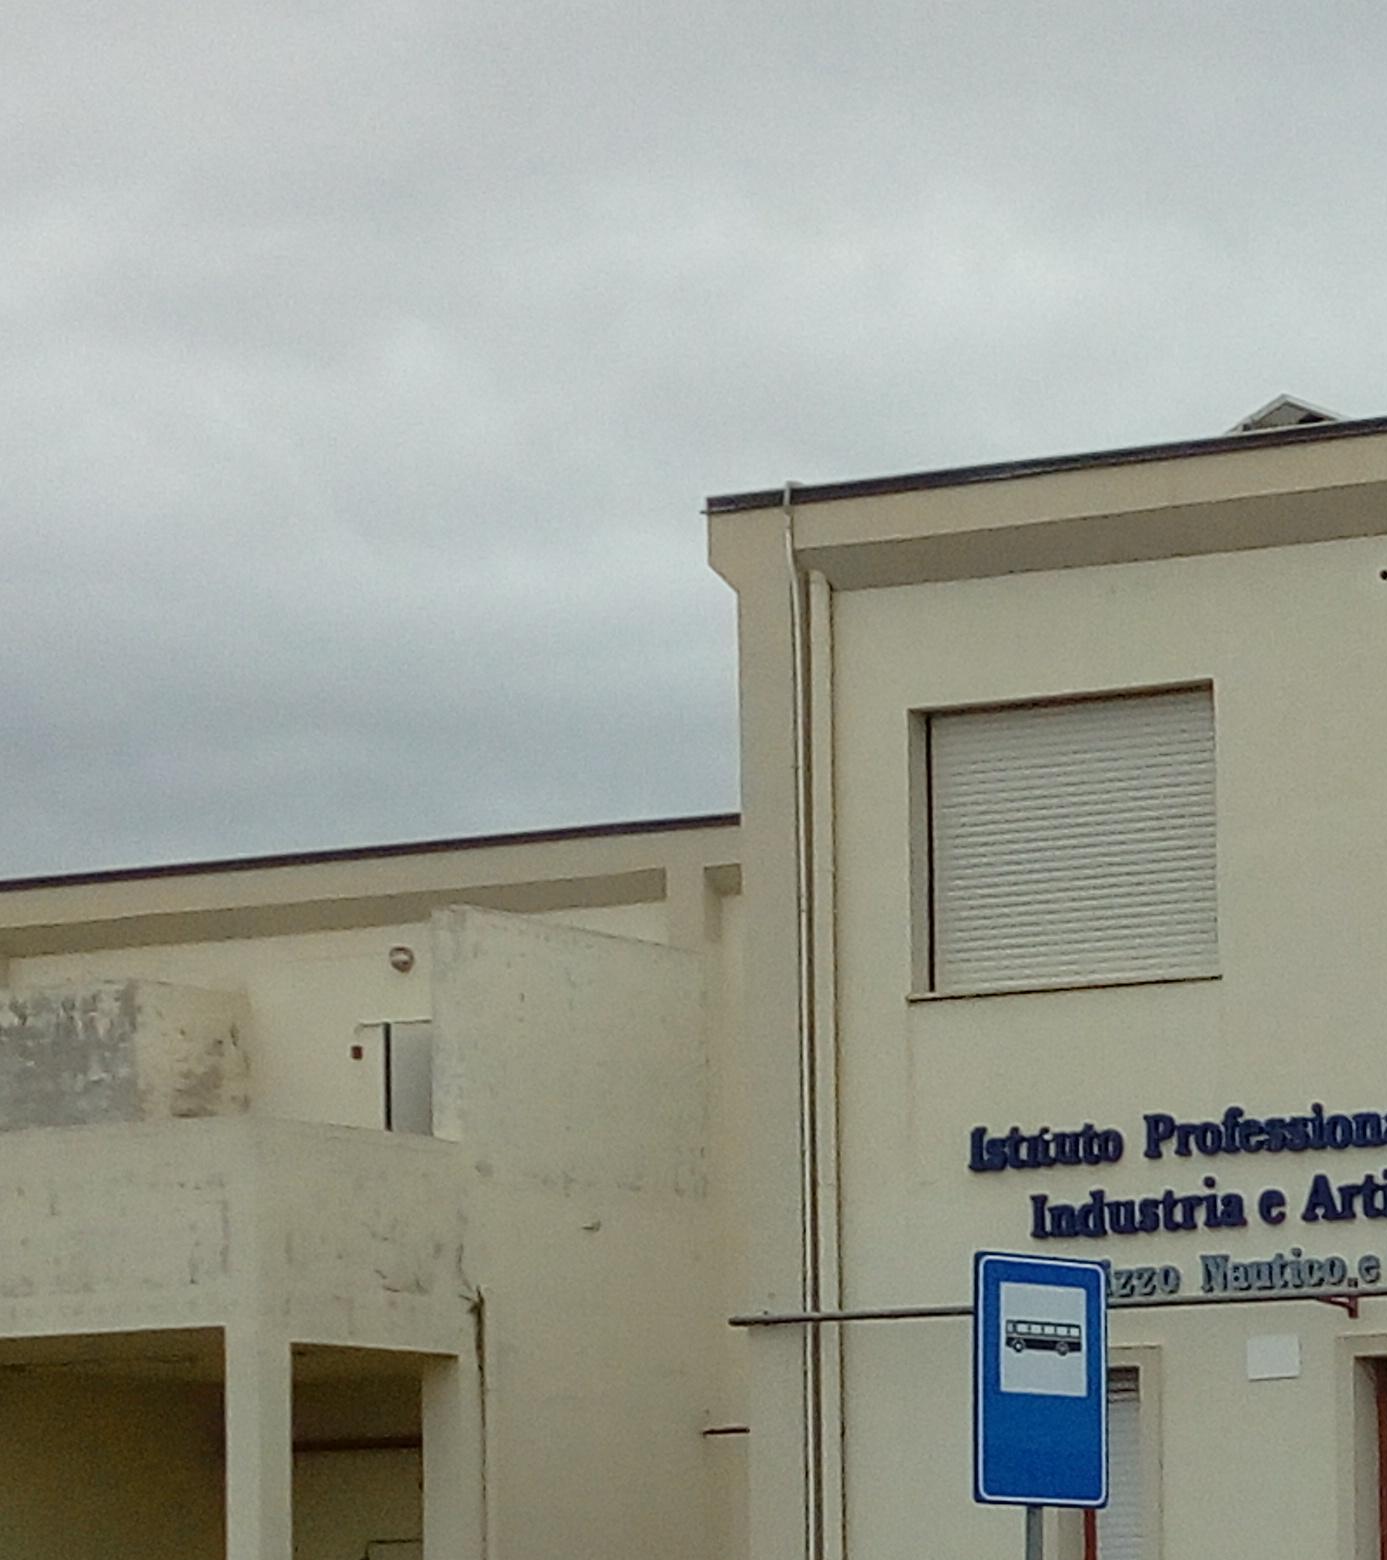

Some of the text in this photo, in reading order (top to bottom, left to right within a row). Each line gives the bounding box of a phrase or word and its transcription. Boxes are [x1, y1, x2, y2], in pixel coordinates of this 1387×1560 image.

[1030, 1175, 1246, 1240] Industria
[1259, 1189, 1286, 1225] e
[1358, 1254, 1381, 1284] e
